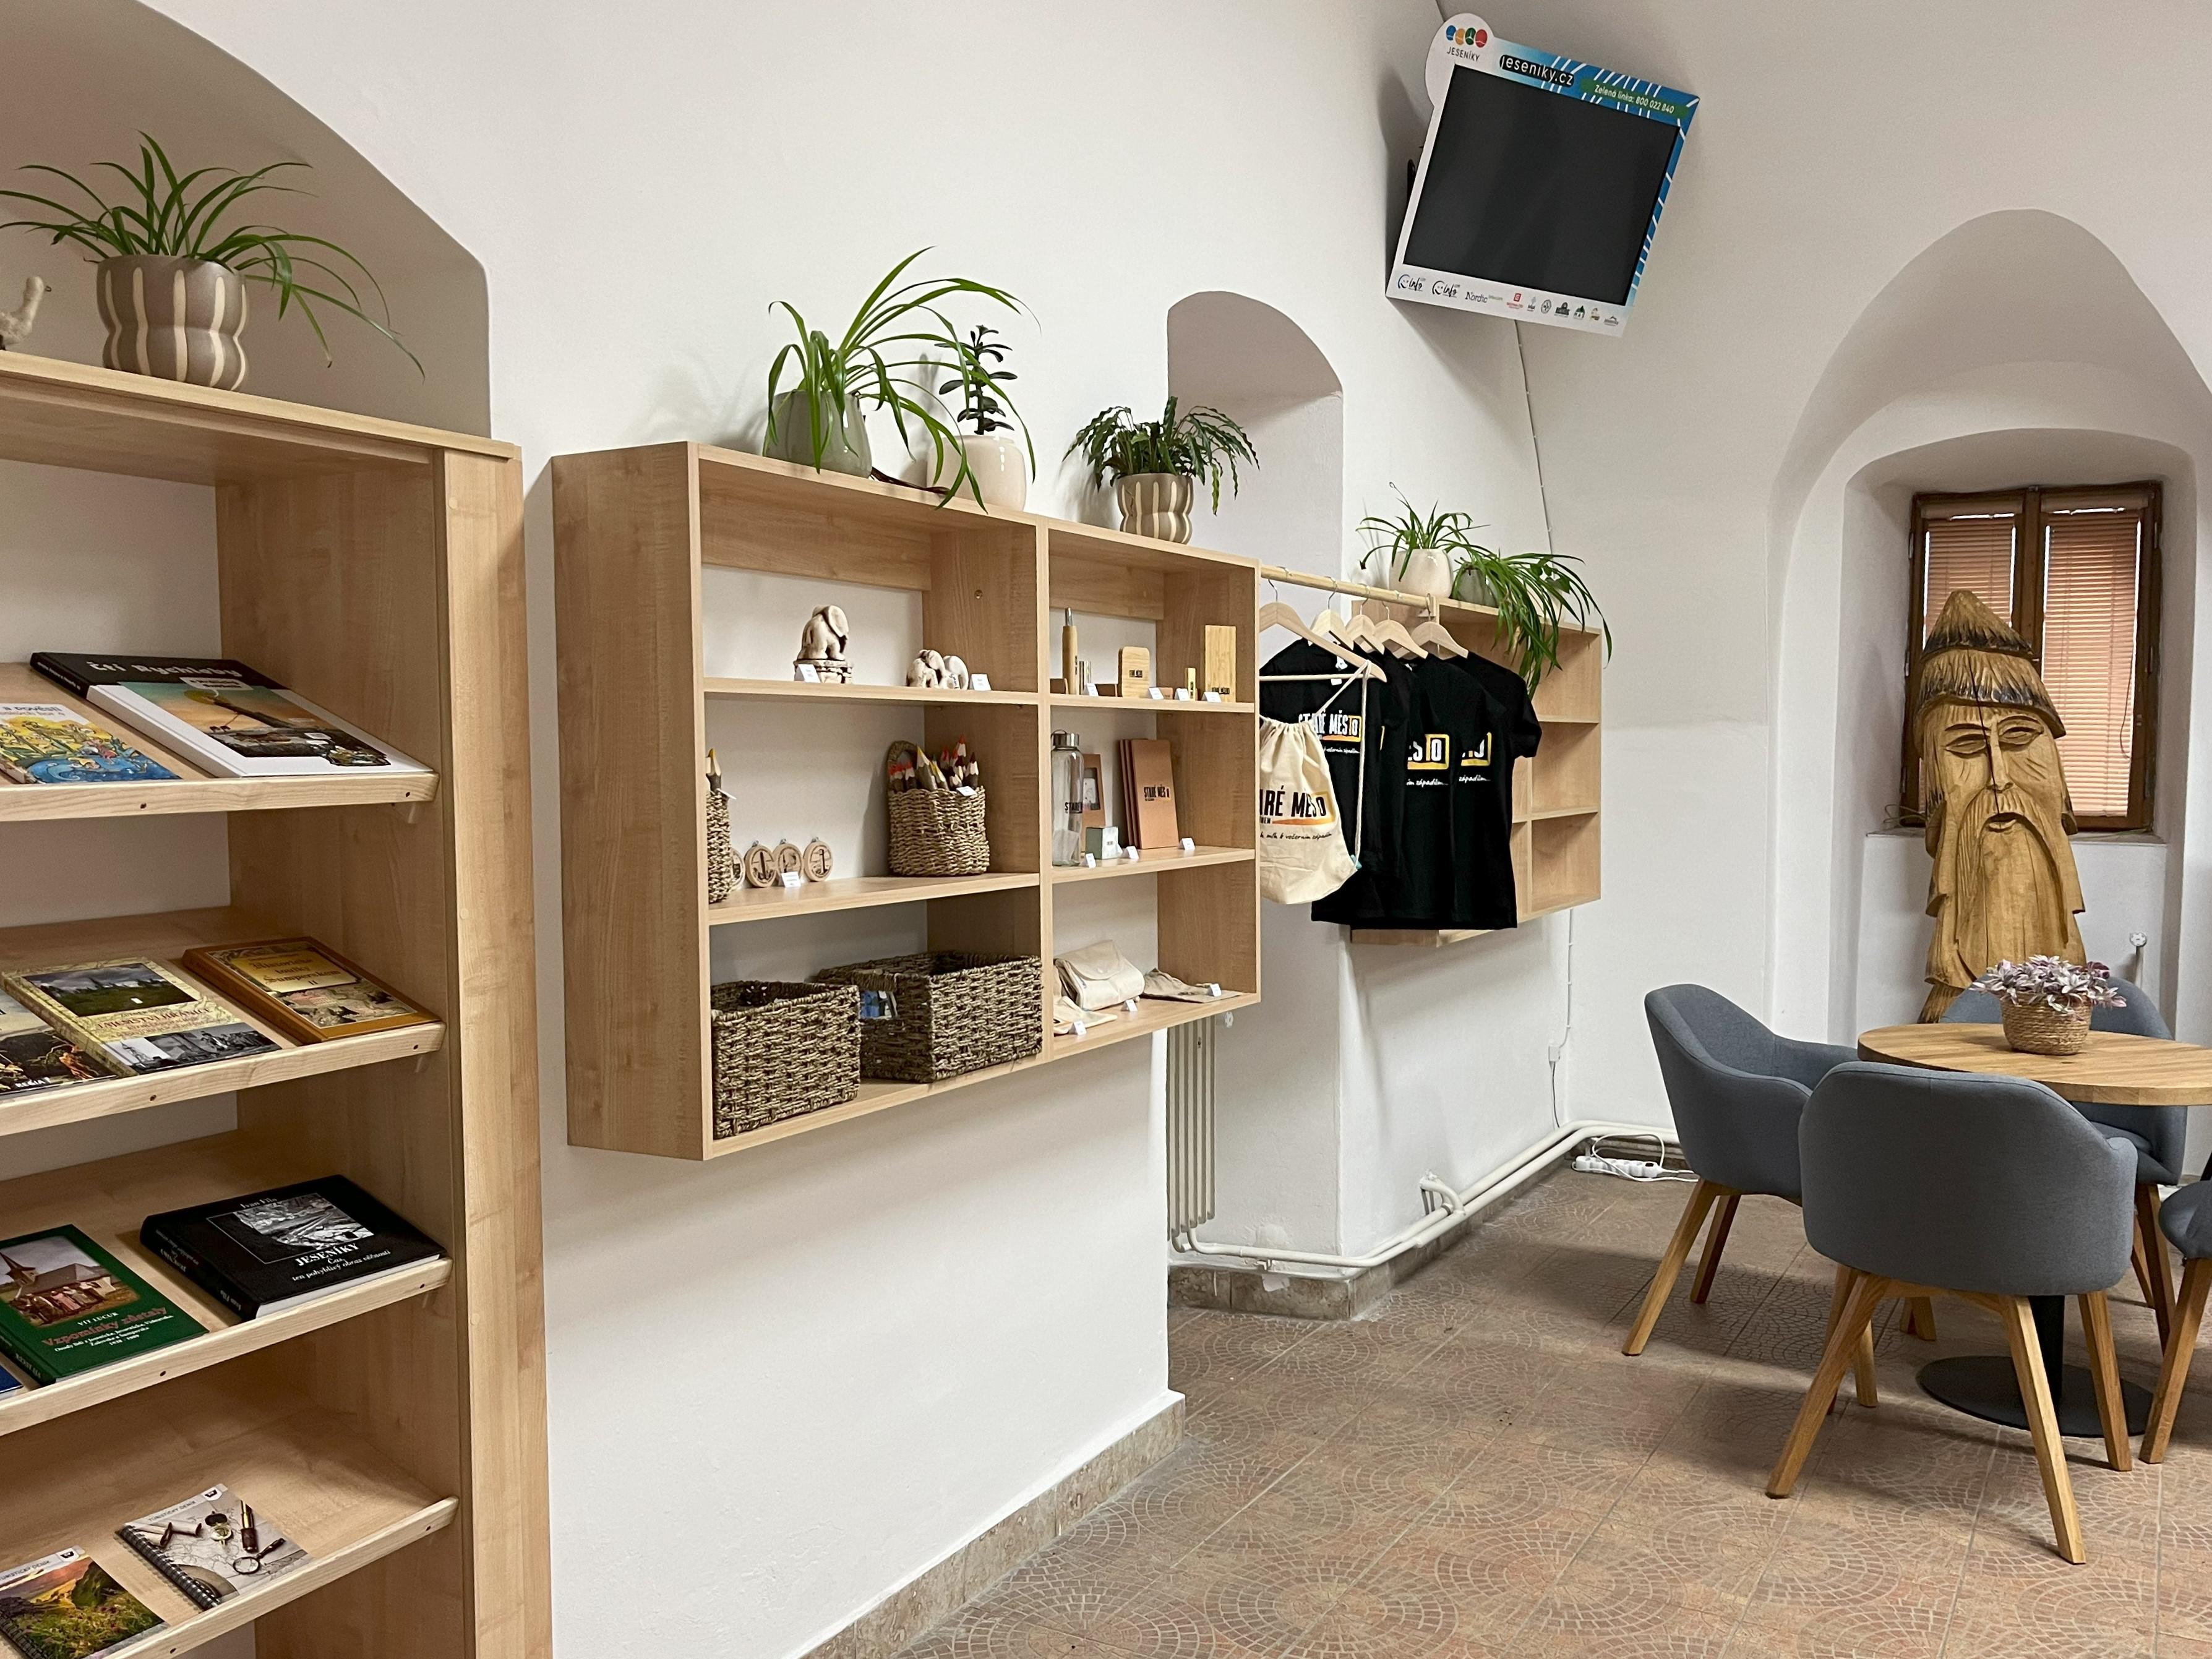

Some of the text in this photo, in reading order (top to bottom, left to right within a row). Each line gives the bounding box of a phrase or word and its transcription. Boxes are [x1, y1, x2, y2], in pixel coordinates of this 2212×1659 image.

[1447, 46, 1480, 62] JESENÍKY
[1595, 85, 1674, 113] Zelená linka: 800 022 840
[1465, 291, 1488, 303] Nordic
[1329, 709, 1358, 736] MĚSTO
[98, 1014, 160, 1029] TAJEMSTVÍ
[295, 1243, 359, 1266] JESENÍKY
[306, 1264, 341, 1279] pohyblivý
[343, 1258, 362, 1267] obraz
[363, 1250, 391, 1261] věčnosti
[41, 1307, 167, 1347] Vzpomínky zůstaly
[0, 1567, 30, 1580] URISTICKÝ
